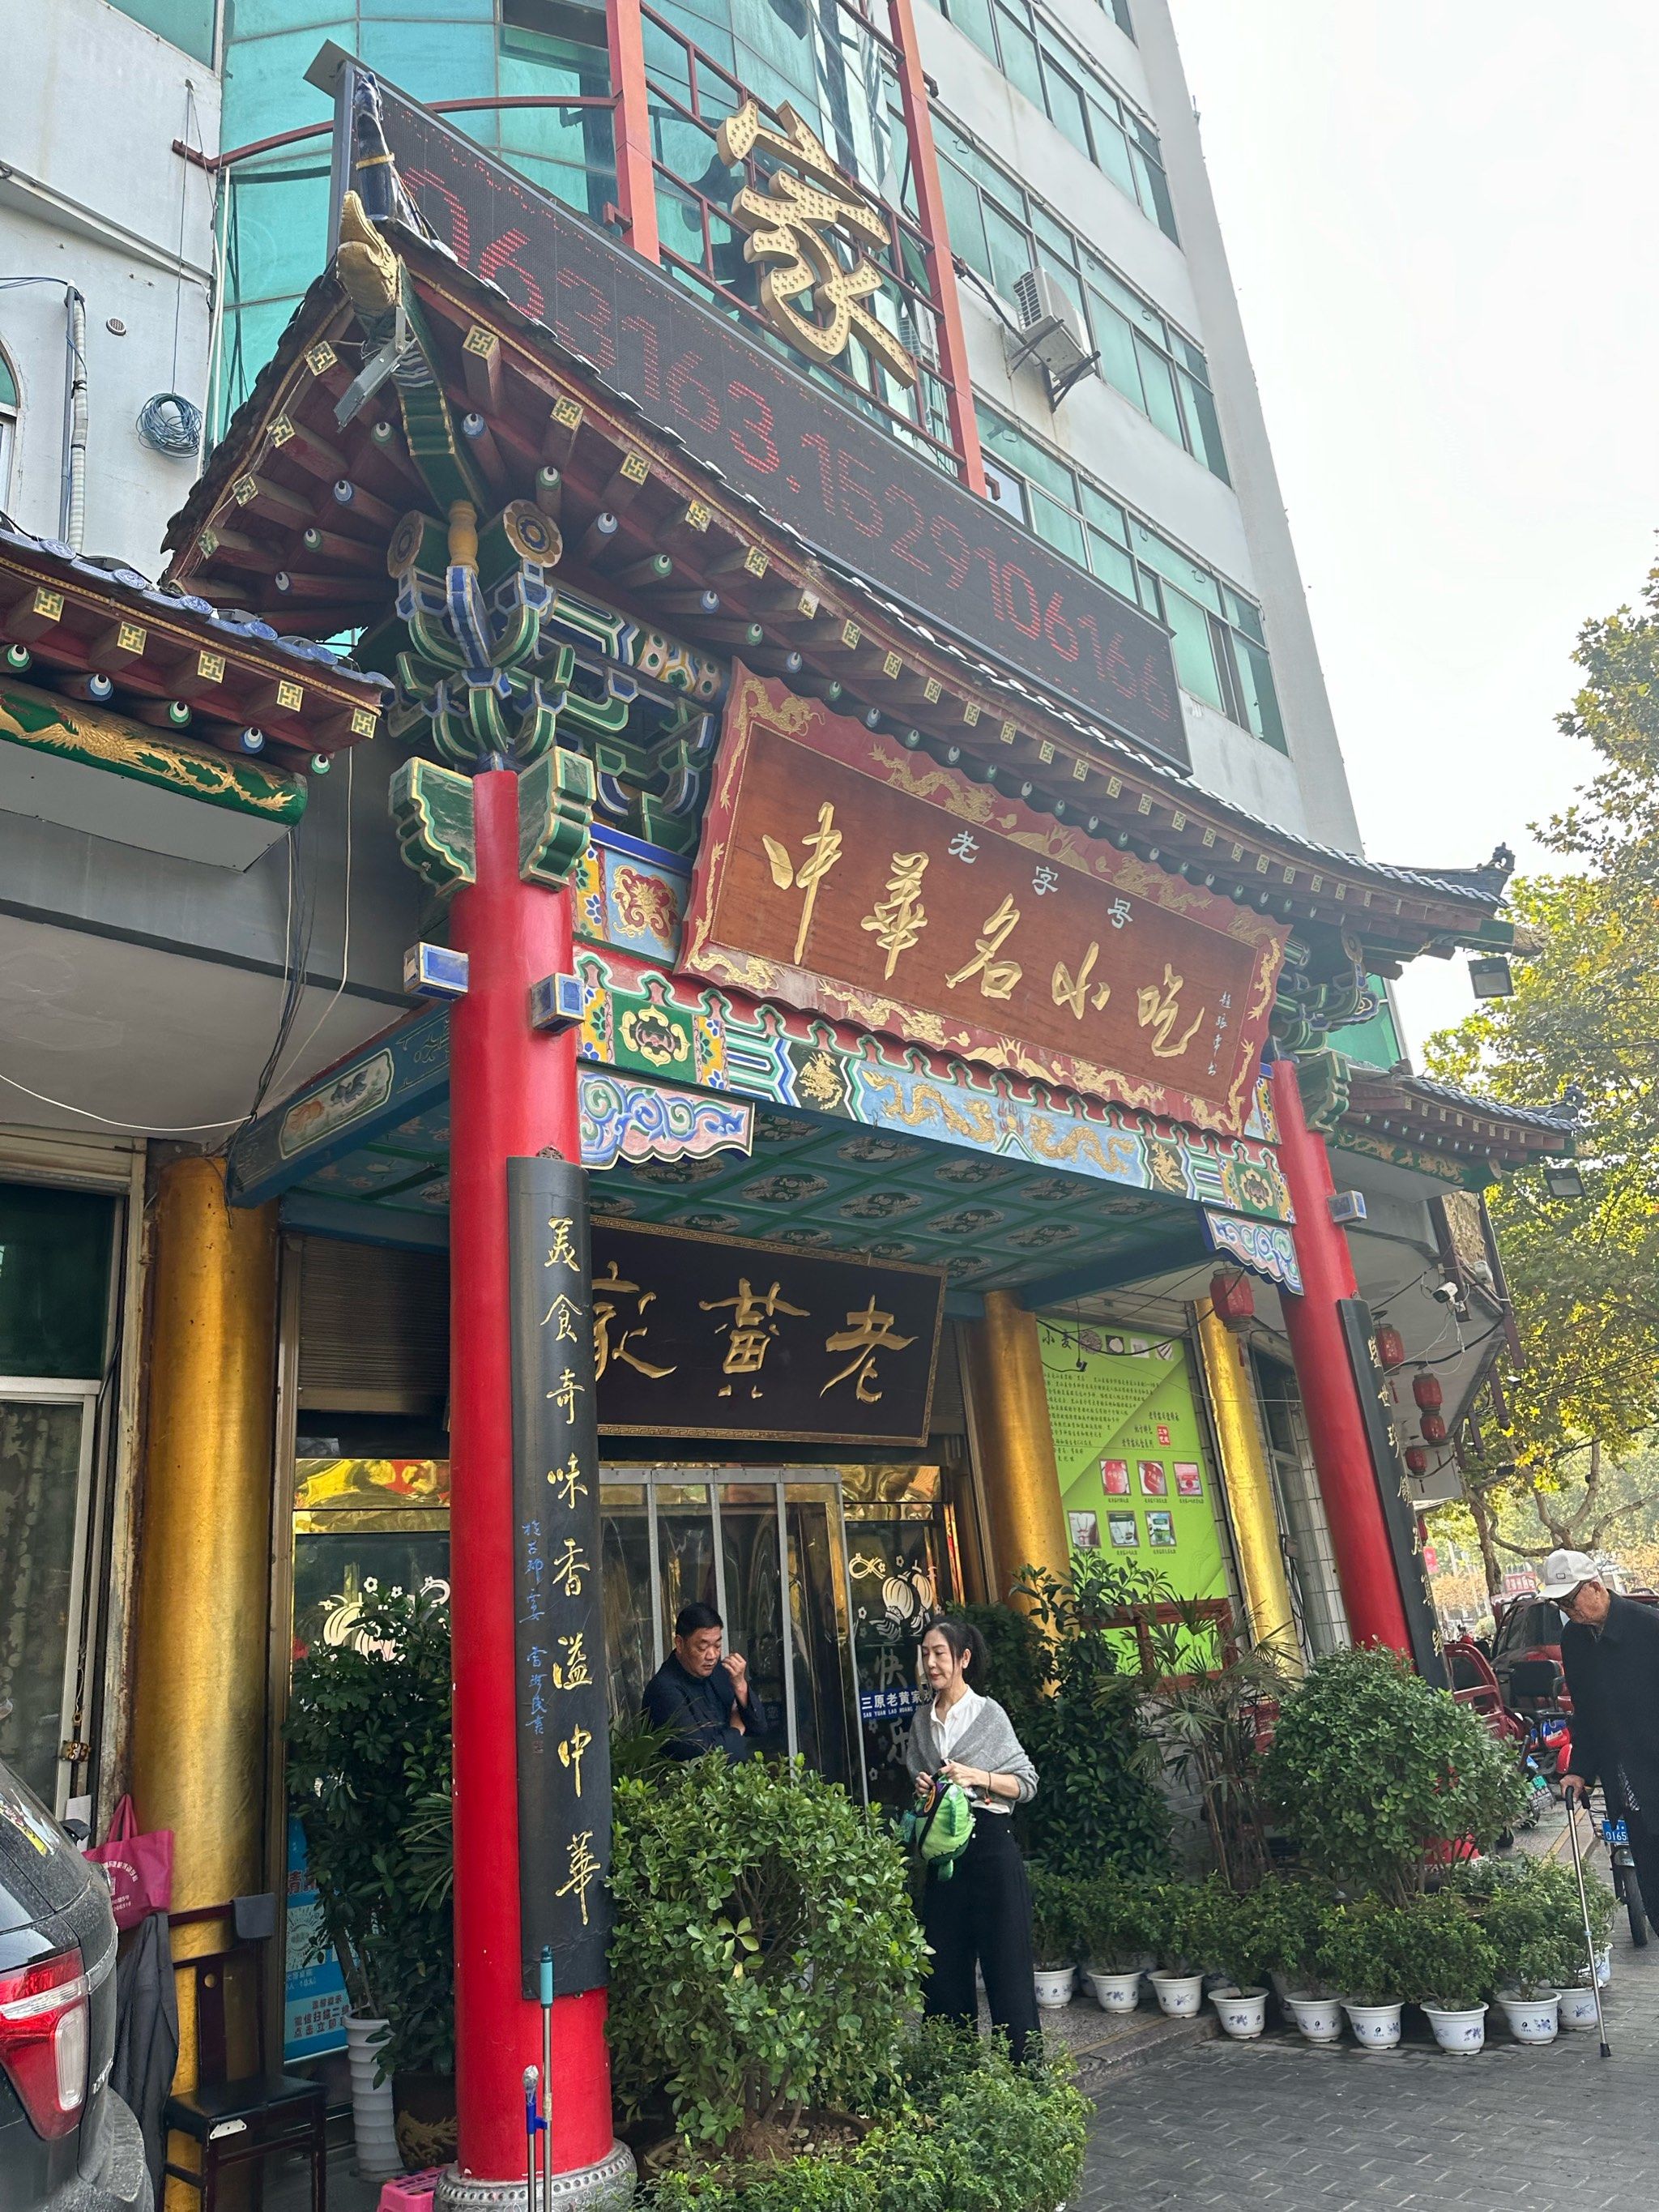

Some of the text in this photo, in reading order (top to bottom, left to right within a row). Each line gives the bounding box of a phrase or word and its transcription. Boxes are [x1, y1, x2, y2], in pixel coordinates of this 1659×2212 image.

[948, 831, 1133, 929] 老字号
[294, 2018, 344, 2038] 点击立即
